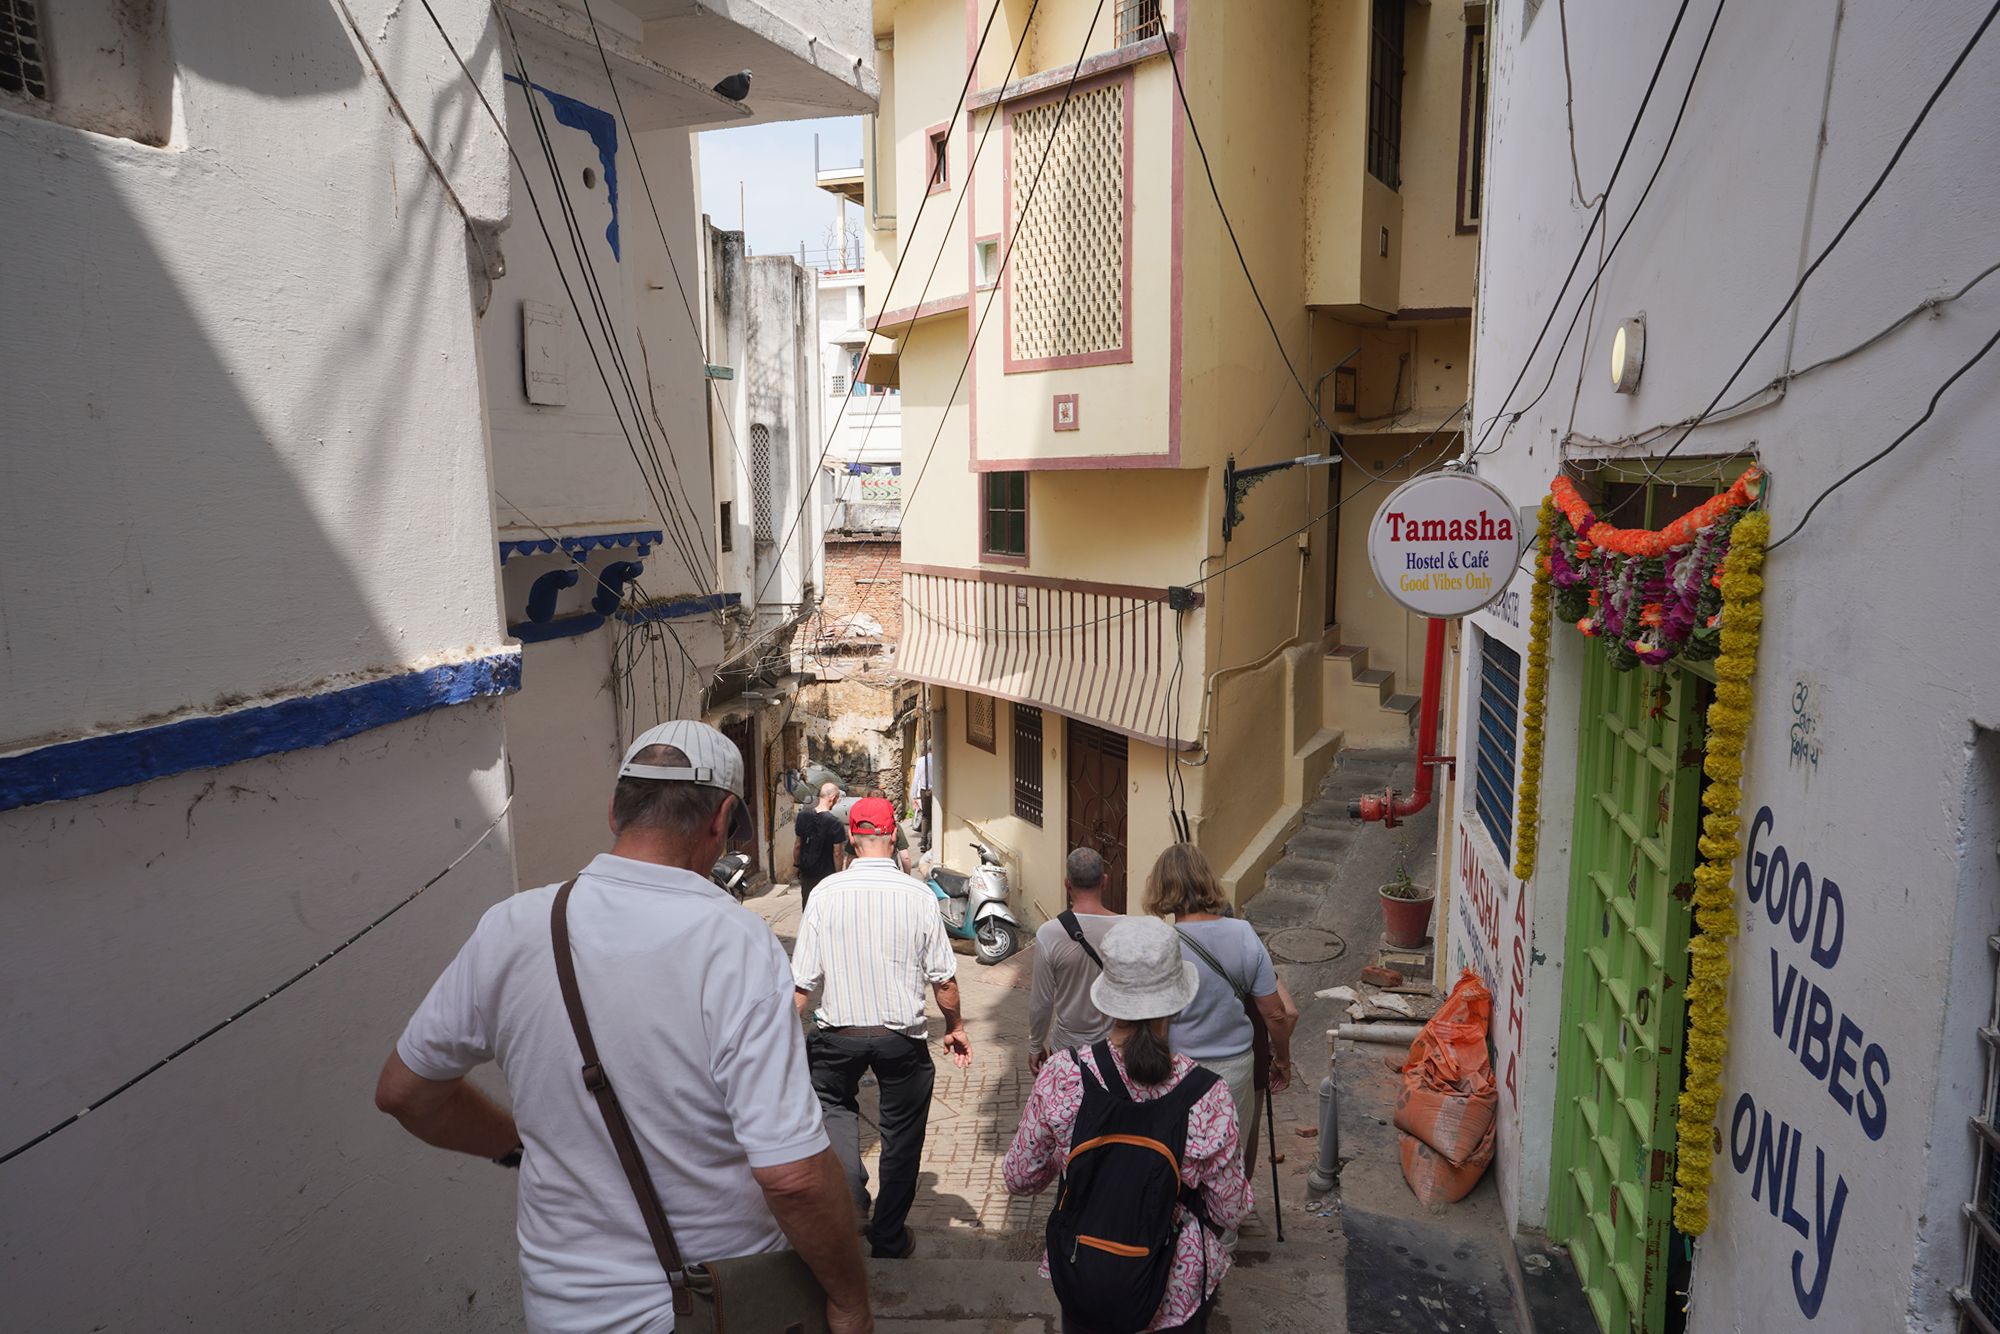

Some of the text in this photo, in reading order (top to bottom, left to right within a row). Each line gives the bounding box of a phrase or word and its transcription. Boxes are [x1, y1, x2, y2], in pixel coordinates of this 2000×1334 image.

[1386, 510, 1513, 542] Tamasha
[1406, 550, 1489, 570] Hostel & Café
[1400, 571, 1493, 595] Good Vibes Only
[1459, 821, 1500, 961] TAMASHA
[1745, 805, 1845, 970] GOOD
[1769, 947, 1892, 1142] VIBES
